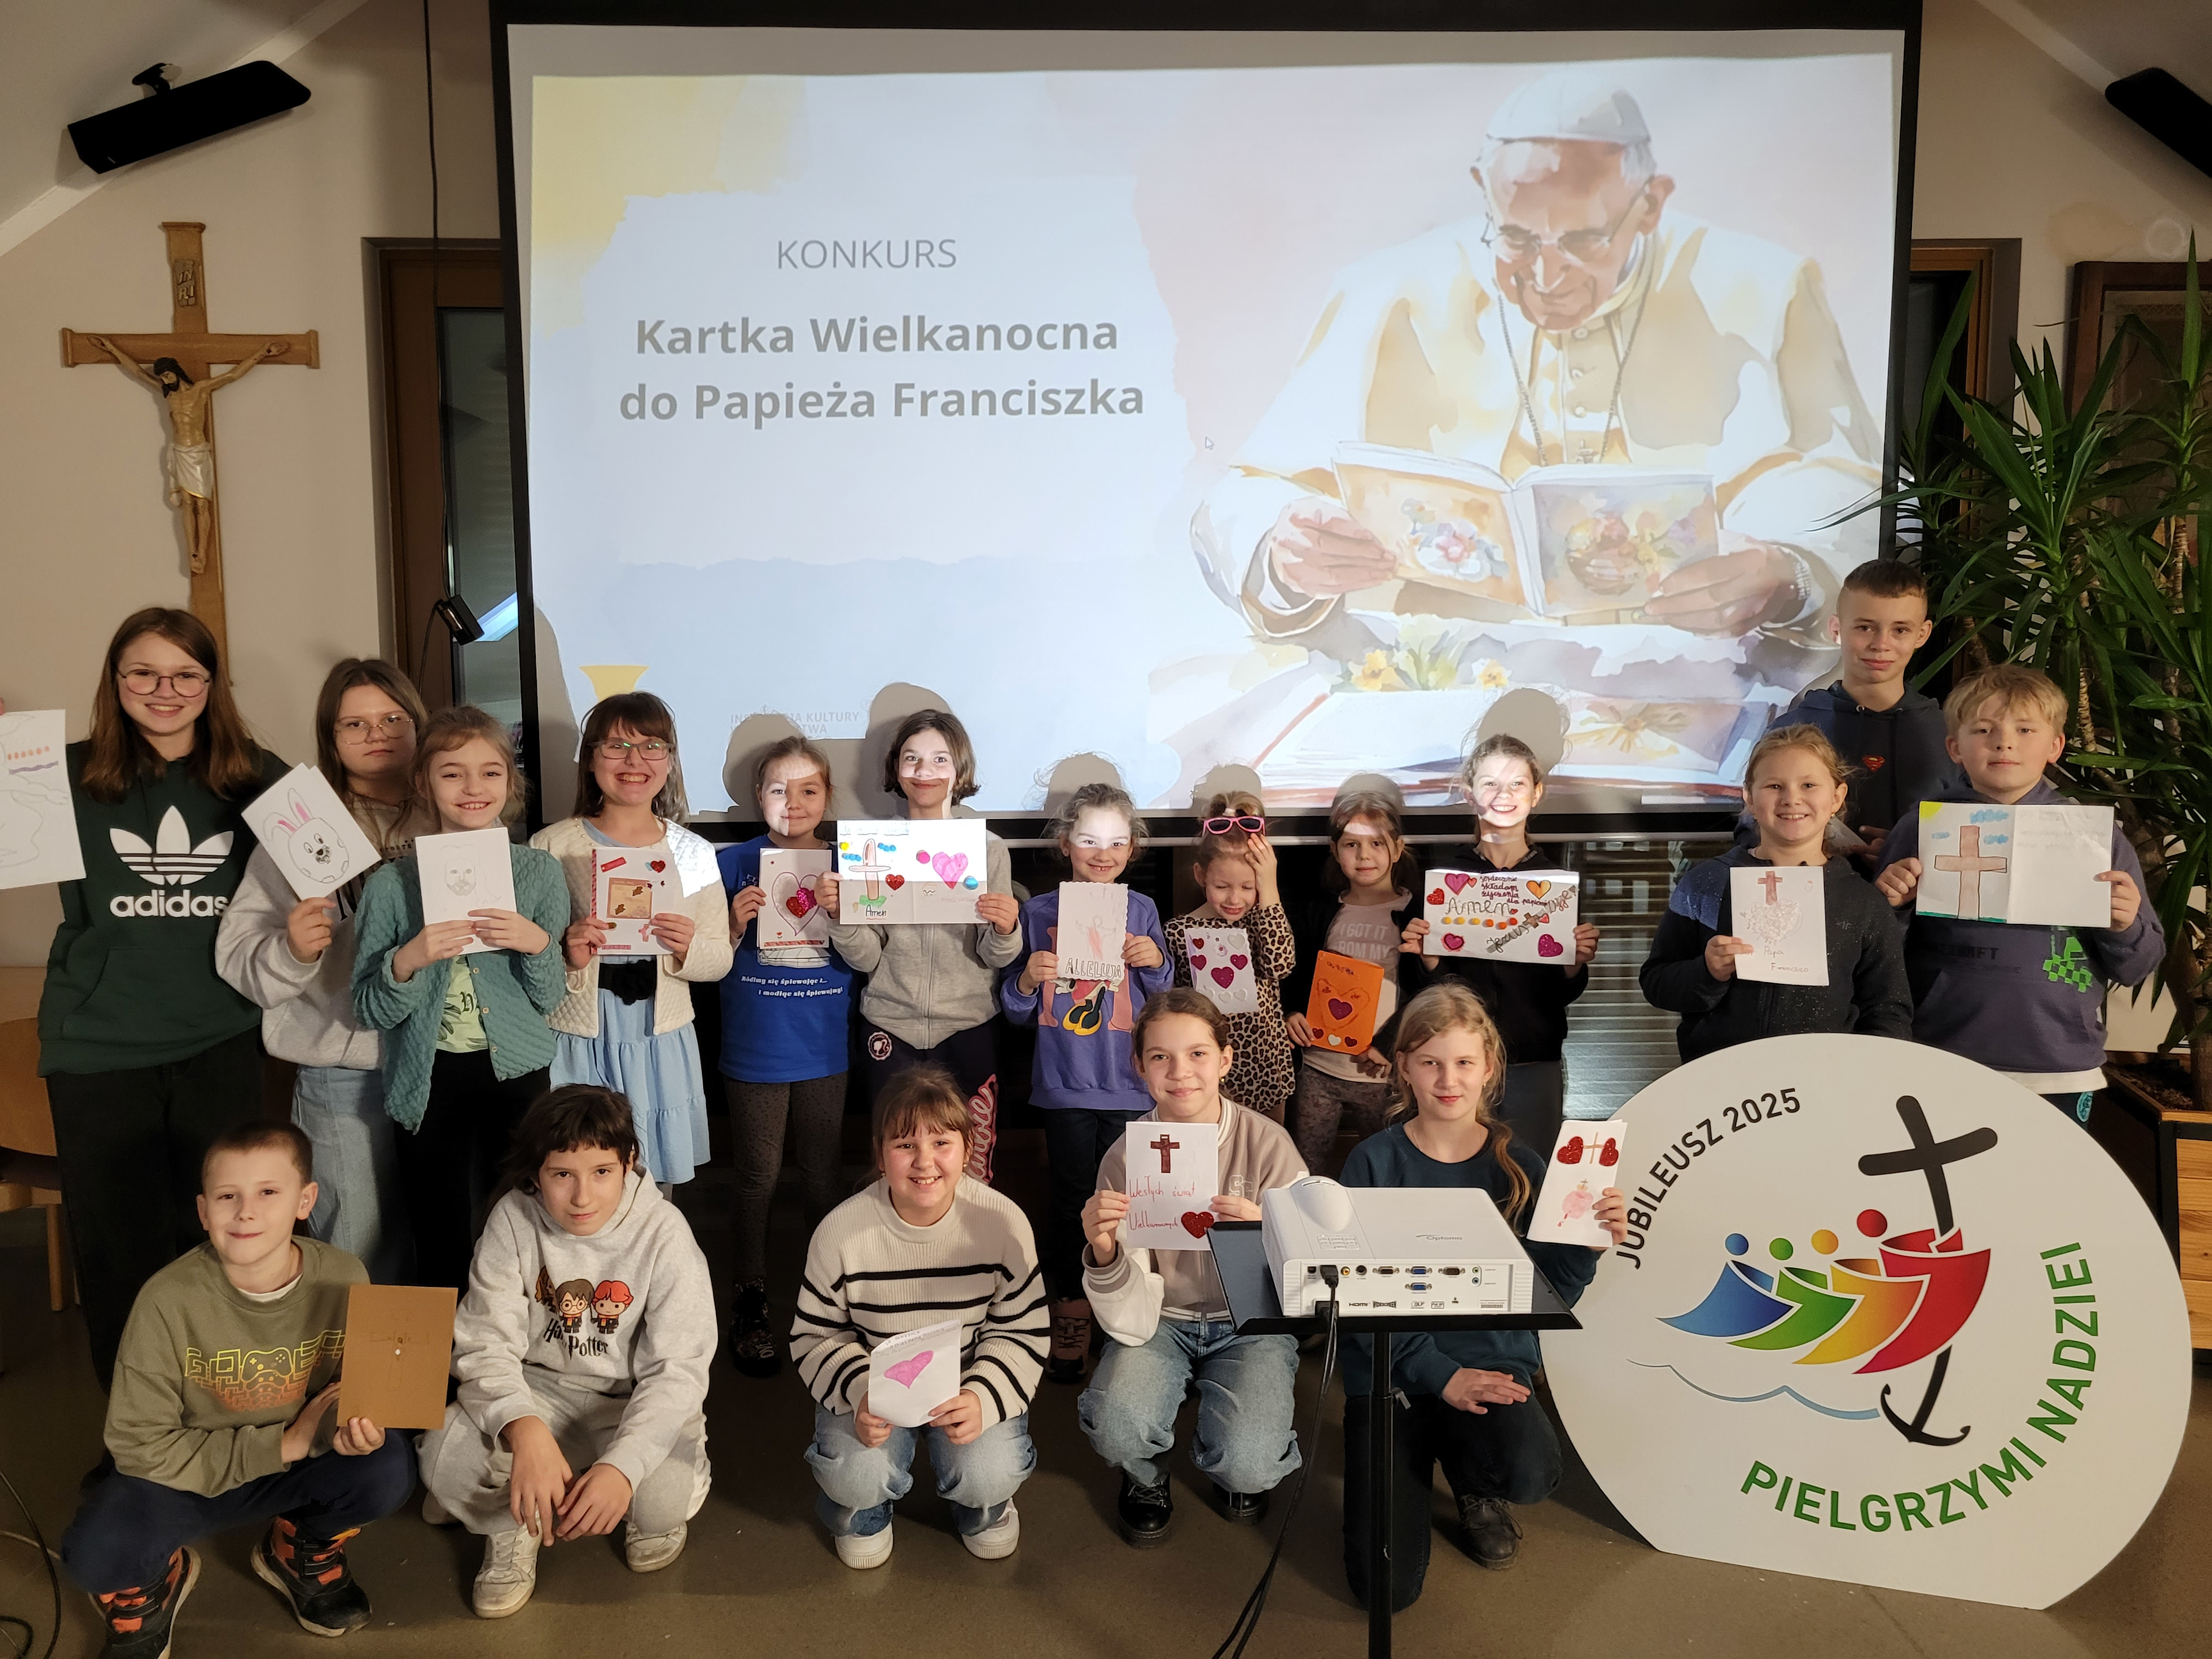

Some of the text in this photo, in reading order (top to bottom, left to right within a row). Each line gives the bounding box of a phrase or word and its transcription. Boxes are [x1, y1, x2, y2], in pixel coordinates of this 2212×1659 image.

[778, 239, 957, 269] KONKURS
[636, 315, 1118, 354] Kartka Wielkanocna
[619, 378, 1144, 430] do Papieża Franciszka
[806, 711, 860, 722] KULTURY
[109, 889, 229, 918] adidas
[865, 904, 887, 917] Amen
[1445, 897, 1512, 916] Amen
[1340, 923, 1389, 940] I GOT IT
[1328, 940, 1391, 960] ROM MY
[1763, 946, 1783, 958] Papa
[1065, 957, 1122, 979] ALLELUJA
[767, 978, 779, 986] się
[1616, 1088, 1801, 1270] JUBILEUSZ 2025
[569, 1335, 610, 1361] Potter
[1740, 1241, 2099, 1532] PIELGRZYMI NADZIEI
